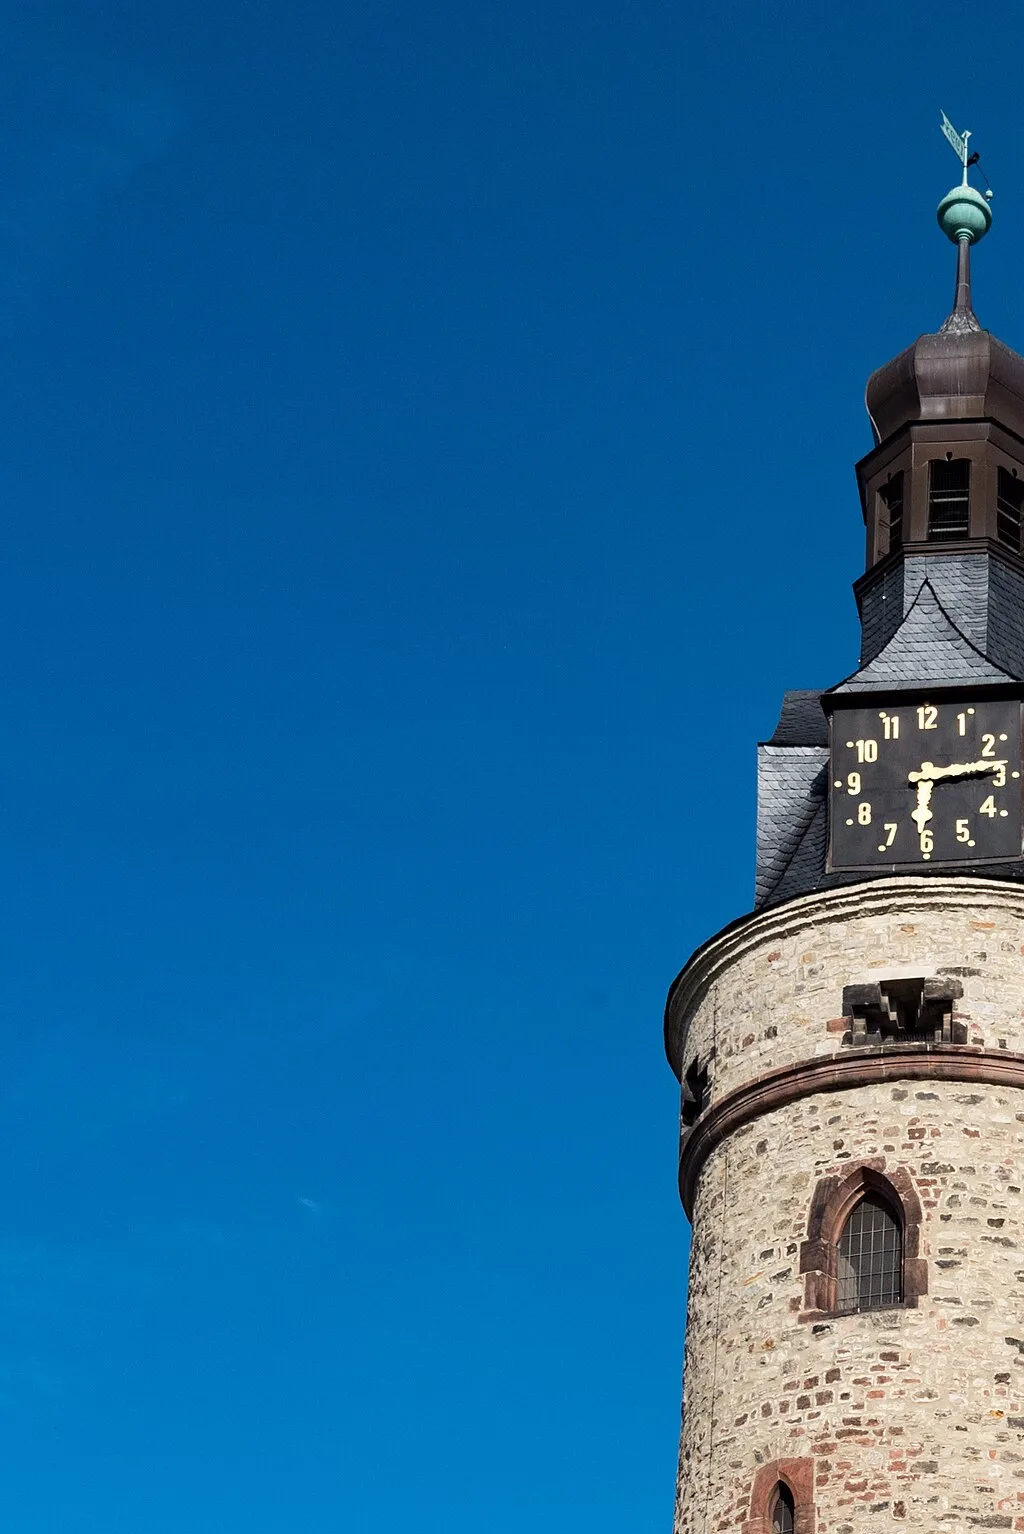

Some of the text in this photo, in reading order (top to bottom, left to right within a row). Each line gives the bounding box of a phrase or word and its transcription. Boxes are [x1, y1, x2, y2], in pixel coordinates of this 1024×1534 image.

[883, 716, 899, 740] 11
[917, 707, 938, 730] 12
[957, 713, 966, 736] 1
[855, 739, 878, 763] 10
[981, 734, 996, 757] 2
[847, 772, 861, 795] 9
[992, 764, 1006, 787] 3
[858, 802, 872, 825] 8
[979, 796, 997, 818] 4
[884, 823, 898, 846] 7
[920, 830, 934, 853] 6
[956, 819, 970, 842] 5
